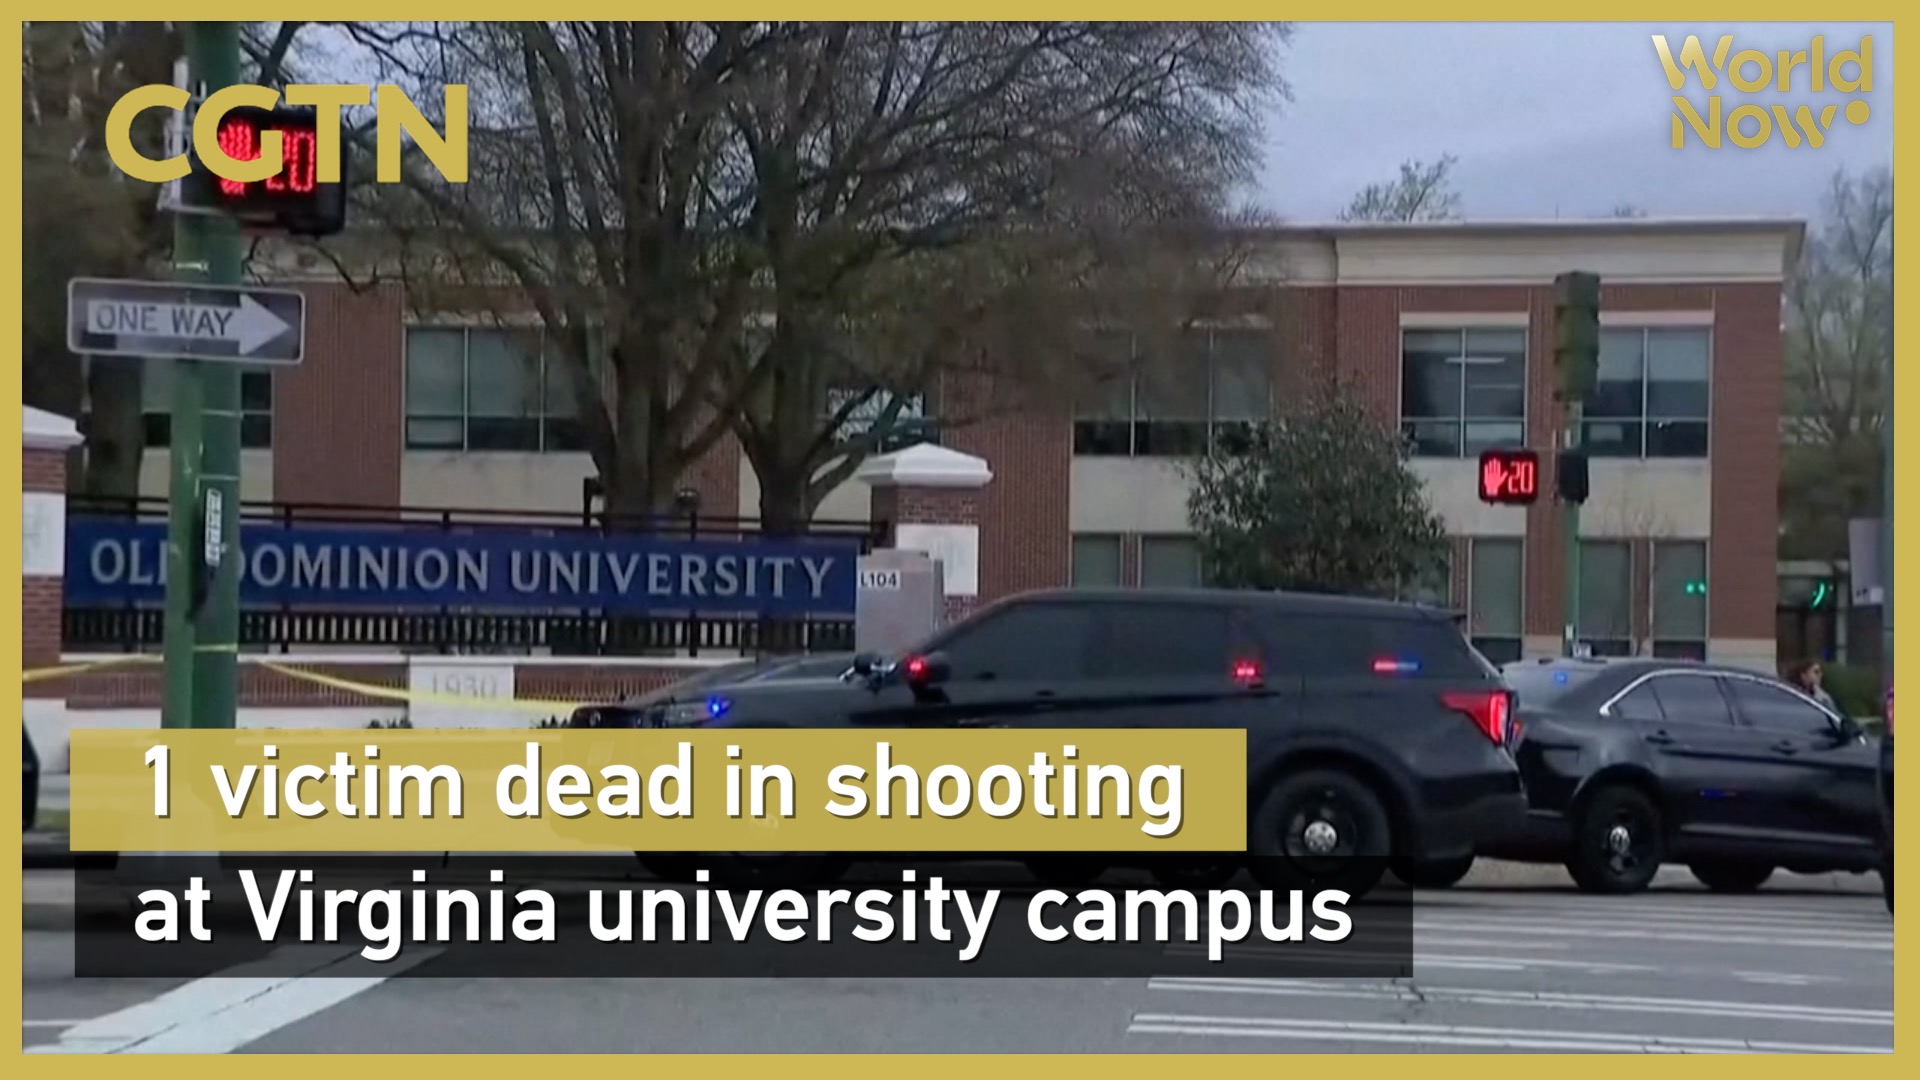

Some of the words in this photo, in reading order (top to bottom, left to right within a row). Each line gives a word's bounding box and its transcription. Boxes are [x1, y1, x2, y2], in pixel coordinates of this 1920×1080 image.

[95, 304, 158, 333] ONE
[170, 306, 233, 337] WAY
[1508, 461, 1534, 494] 20
[239, 541, 489, 593] OMINION
[509, 549, 834, 599] UNIVERSITY
[860, 571, 897, 588] L104
